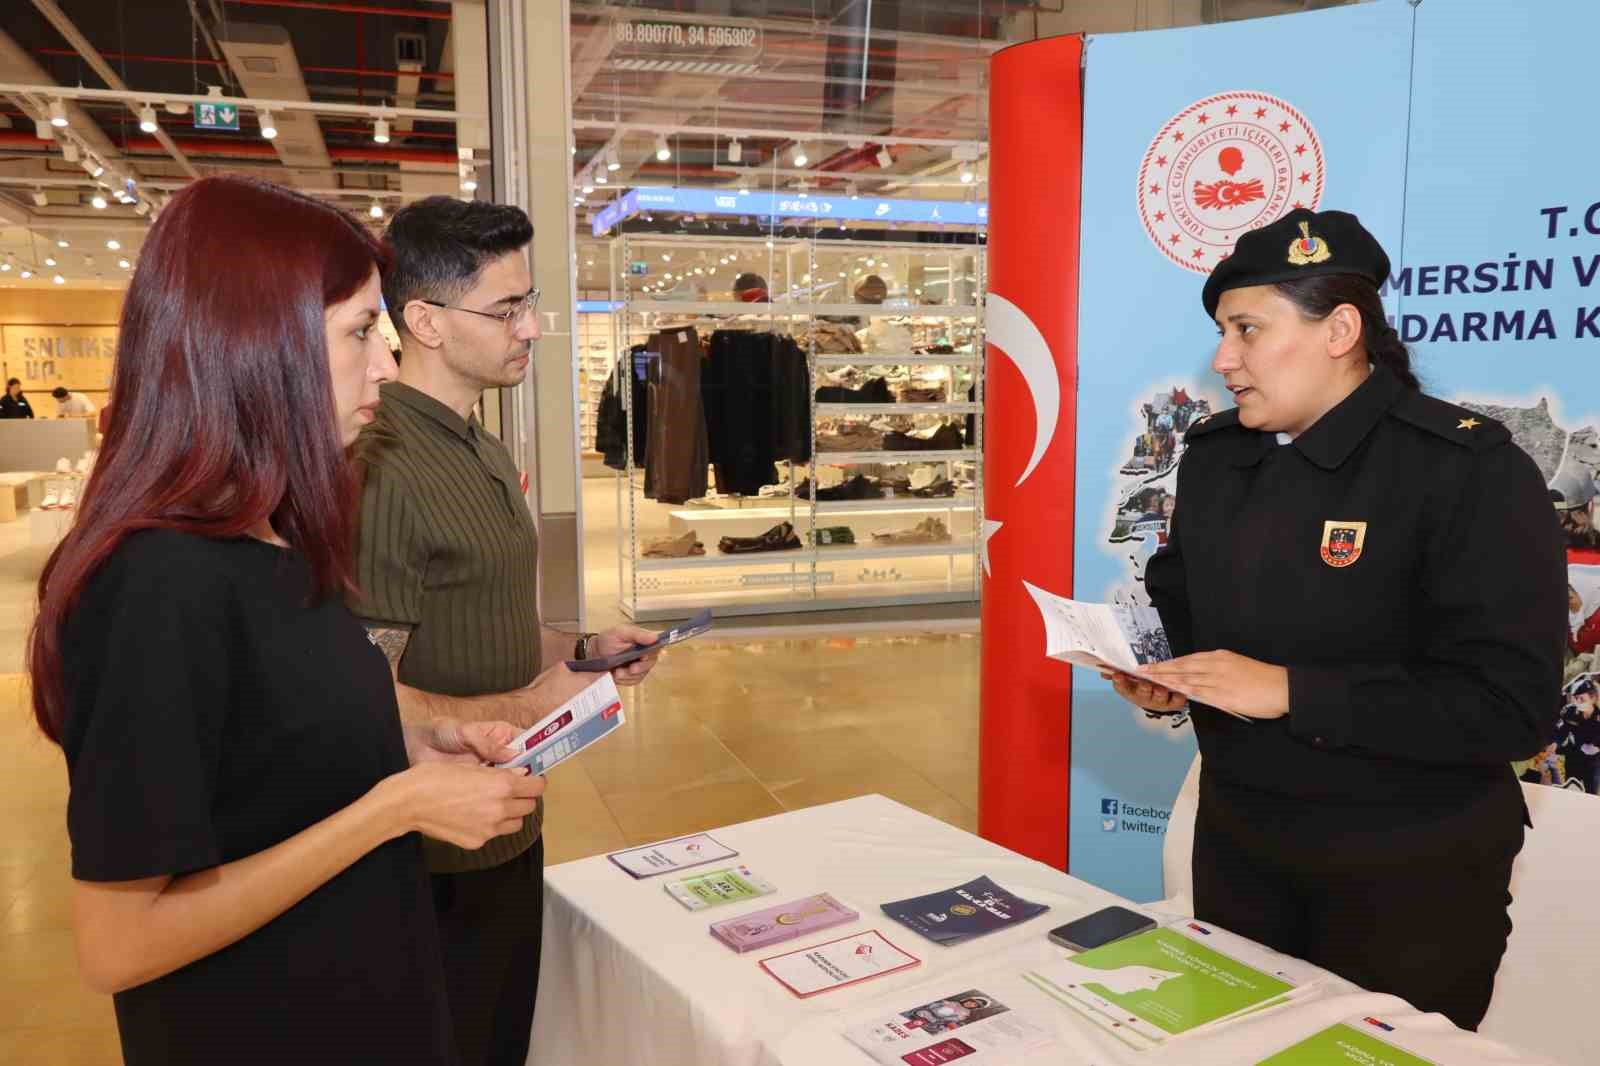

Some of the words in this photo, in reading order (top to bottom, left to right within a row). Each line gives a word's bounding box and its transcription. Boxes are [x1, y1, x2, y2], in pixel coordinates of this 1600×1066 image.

[1172, 191, 1204, 237] TÜRKİYE
[1379, 252, 1554, 297] MERSİN
[1387, 308, 1557, 343] DARMA
